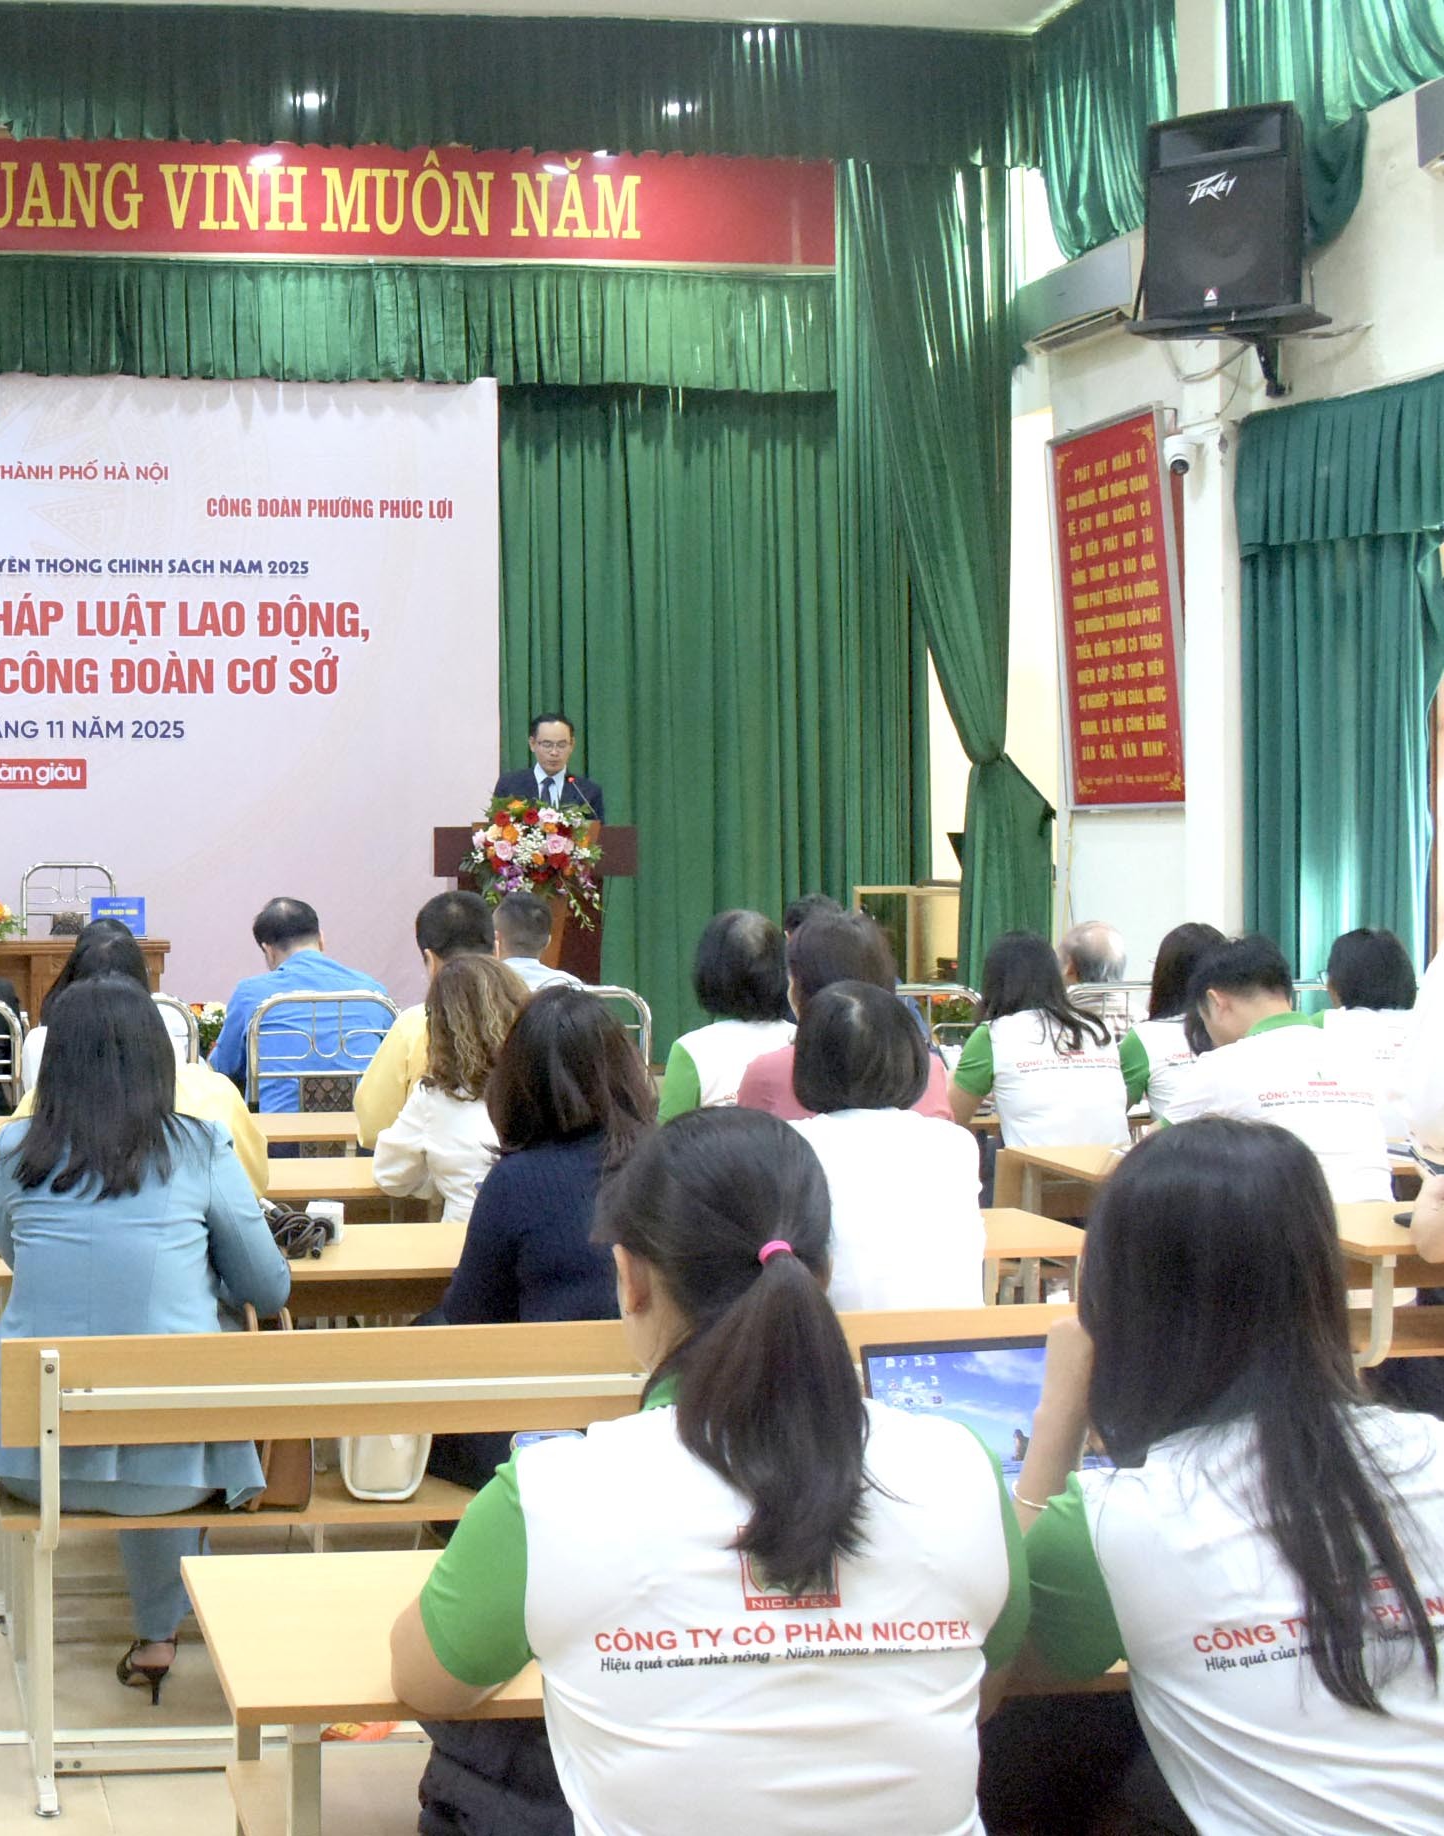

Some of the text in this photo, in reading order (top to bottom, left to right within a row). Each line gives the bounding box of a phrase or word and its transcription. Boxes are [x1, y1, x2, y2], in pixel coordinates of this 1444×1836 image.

[159, 163, 307, 232] VINH
[322, 150, 495, 236] MUÔN
[511, 157, 642, 240] NĂM
[59, 458, 98, 480] PHỐ
[104, 460, 130, 480] HÀ
[136, 461, 169, 485] NỘI
[206, 494, 453, 522] CÔNG ĐOÀN PHƯỜNG PHÚC LỢI
[268, 561, 309, 575] 2025
[77, 593, 166, 645] LUẬT
[178, 600, 245, 638] LAO
[257, 593, 370, 646] ĐỘNG,
[110, 650, 214, 695] ĐOÀN
[227, 655, 277, 695] CƠ
[289, 646, 340, 695] SỞ
[48, 722, 64, 739] 11
[73, 717, 124, 739] NĂM
[131, 721, 185, 740] 2025
[36, 762, 81, 786] giàu
[751, 1598, 836, 1610] NICOTEX
[595, 1627, 677, 1653] CÔNG
[686, 1628, 723, 1648] TY
[873, 1621, 972, 1641] NICOTEX
[1193, 1623, 1276, 1653] CÔNG
[601, 1657, 631, 1674] Hiệu
[699, 1651, 728, 1666] nhà
[732, 1650, 771, 1664] nông
[1205, 1646, 1298, 1672] Hiệu quả của
